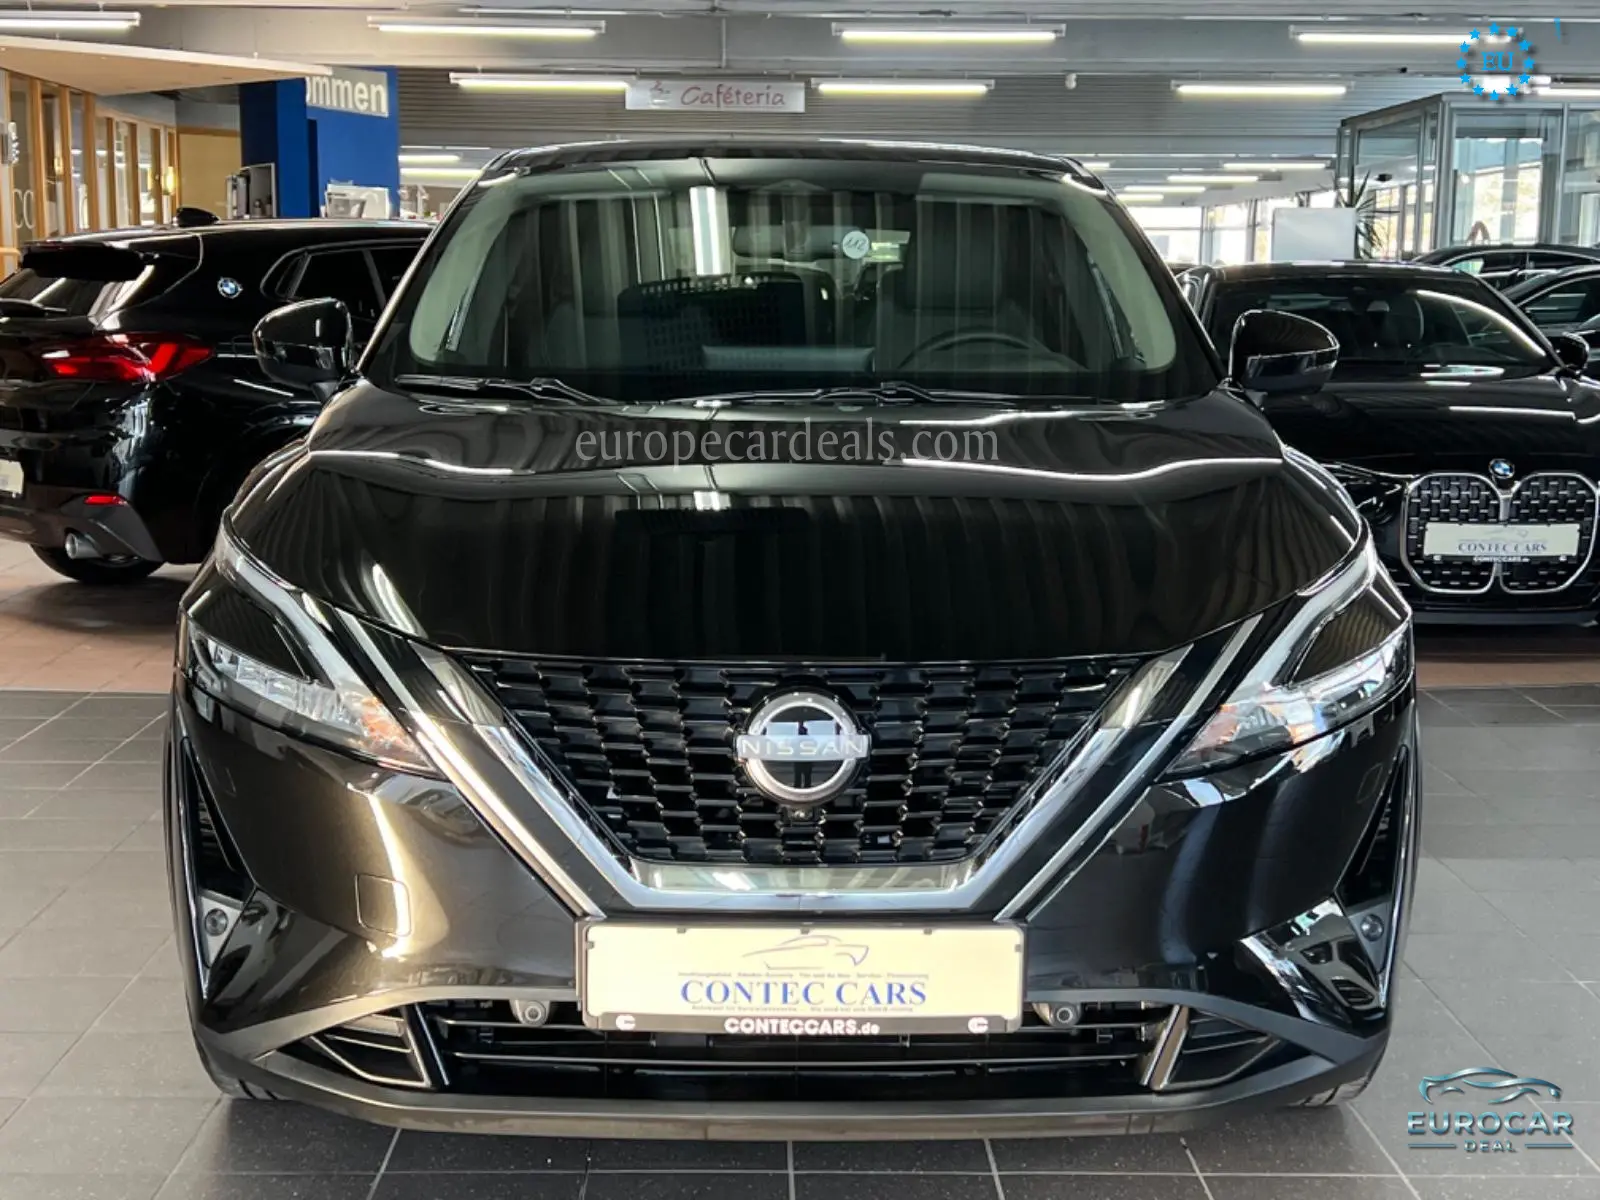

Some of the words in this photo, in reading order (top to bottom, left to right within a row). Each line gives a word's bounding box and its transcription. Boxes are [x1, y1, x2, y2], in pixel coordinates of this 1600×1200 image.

[741, 739, 864, 756] NISSAN
[680, 979, 825, 1006] CONTEC
[835, 980, 927, 1006] CARS
[723, 1017, 881, 1036] CONTECCARS.de
